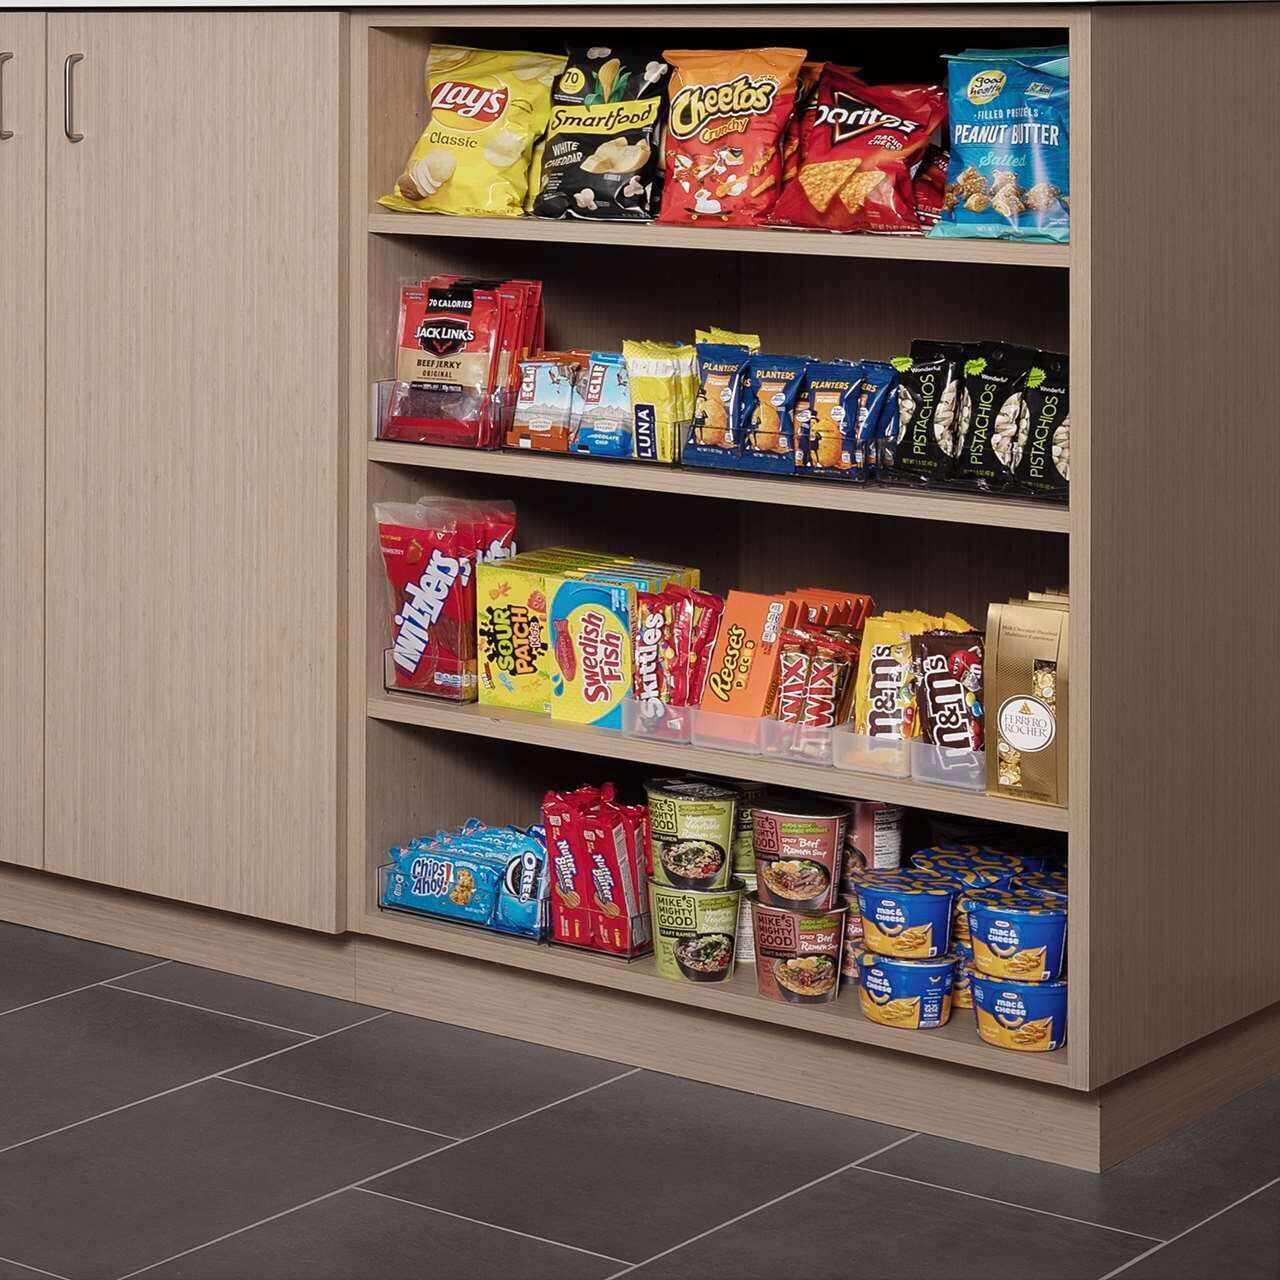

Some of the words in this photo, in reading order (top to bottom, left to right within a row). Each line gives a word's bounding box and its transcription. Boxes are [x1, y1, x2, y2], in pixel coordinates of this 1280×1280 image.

[564, 72, 579, 84] 70
[975, 75, 1003, 89] good
[970, 82, 1002, 96] health
[431, 82, 506, 118] Lay's
[671, 77, 775, 136] Cheetos
[551, 104, 653, 131] Smartfood
[977, 109, 1003, 120] FILLED
[701, 117, 750, 141] Crunchy
[954, 124, 1008, 146] PEANUT
[1011, 123, 1060, 146] BUTTER
[429, 131, 479, 149] Classic
[552, 141, 581, 157] WHITE
[544, 152, 583, 168] CHEDDAR
[979, 151, 1026, 168] Salted
[428, 299, 437, 307] 70
[438, 299, 473, 309] CALORIES
[414, 326, 440, 338] JACK
[416, 359, 436, 367] BEEF
[436, 360, 462, 369] JERKY
[702, 362, 740, 373] PLANTERS
[422, 370, 453, 378] ORIGINAL
[755, 370, 796, 381] PLANTERS
[981, 375, 1009, 383] Wonderful
[810, 380, 851, 390] PLANTERS
[1040, 386, 1065, 395] Wonderful
[913, 373, 935, 455] PISTACHIOS
[970, 383, 997, 465] PISTACHIOS
[638, 408, 653, 458] LUNA
[1029, 395, 1059, 478] PISTACHIOS
[494, 607, 515, 671] SOUR
[511, 605, 536, 675] PATCH
[581, 611, 610, 703] Swedish
[599, 631, 624, 682] Fish
[710, 625, 746, 701] Reese's
[1004, 713, 1048, 729] FERRERO
[1004, 723, 1048, 739] ROCHER
[798, 838, 821, 849] Beef
[556, 839, 577, 876] Nutter
[783, 847, 811, 857] Ramen
[812, 849, 827, 858] Soup
[412, 857, 445, 881] Chips
[555, 856, 575, 891] Butter
[592, 853, 615, 887] Nutter
[413, 863, 453, 897] Ahoy!
[519, 851, 537, 904] OREO
[592, 868, 614, 902] Butter
[657, 896, 693, 909] MIKE'S
[658, 906, 694, 916] MIGHTY
[896, 908, 903, 916] &
[659, 915, 694, 927] GOOD
[757, 914, 793, 928] MIKE'S
[757, 925, 794, 936] MIGHTY
[816, 933, 834, 943] Beef
[989, 927, 1008, 937] mac
[1009, 929, 1017, 938] &
[758, 933, 794, 947] GOOD
[800, 941, 829, 952] Ramen
[867, 975, 882, 984] mac
[883, 979, 890, 987] &
[996, 999, 1016, 1009] mac
[1017, 1001, 1025, 1010] &
